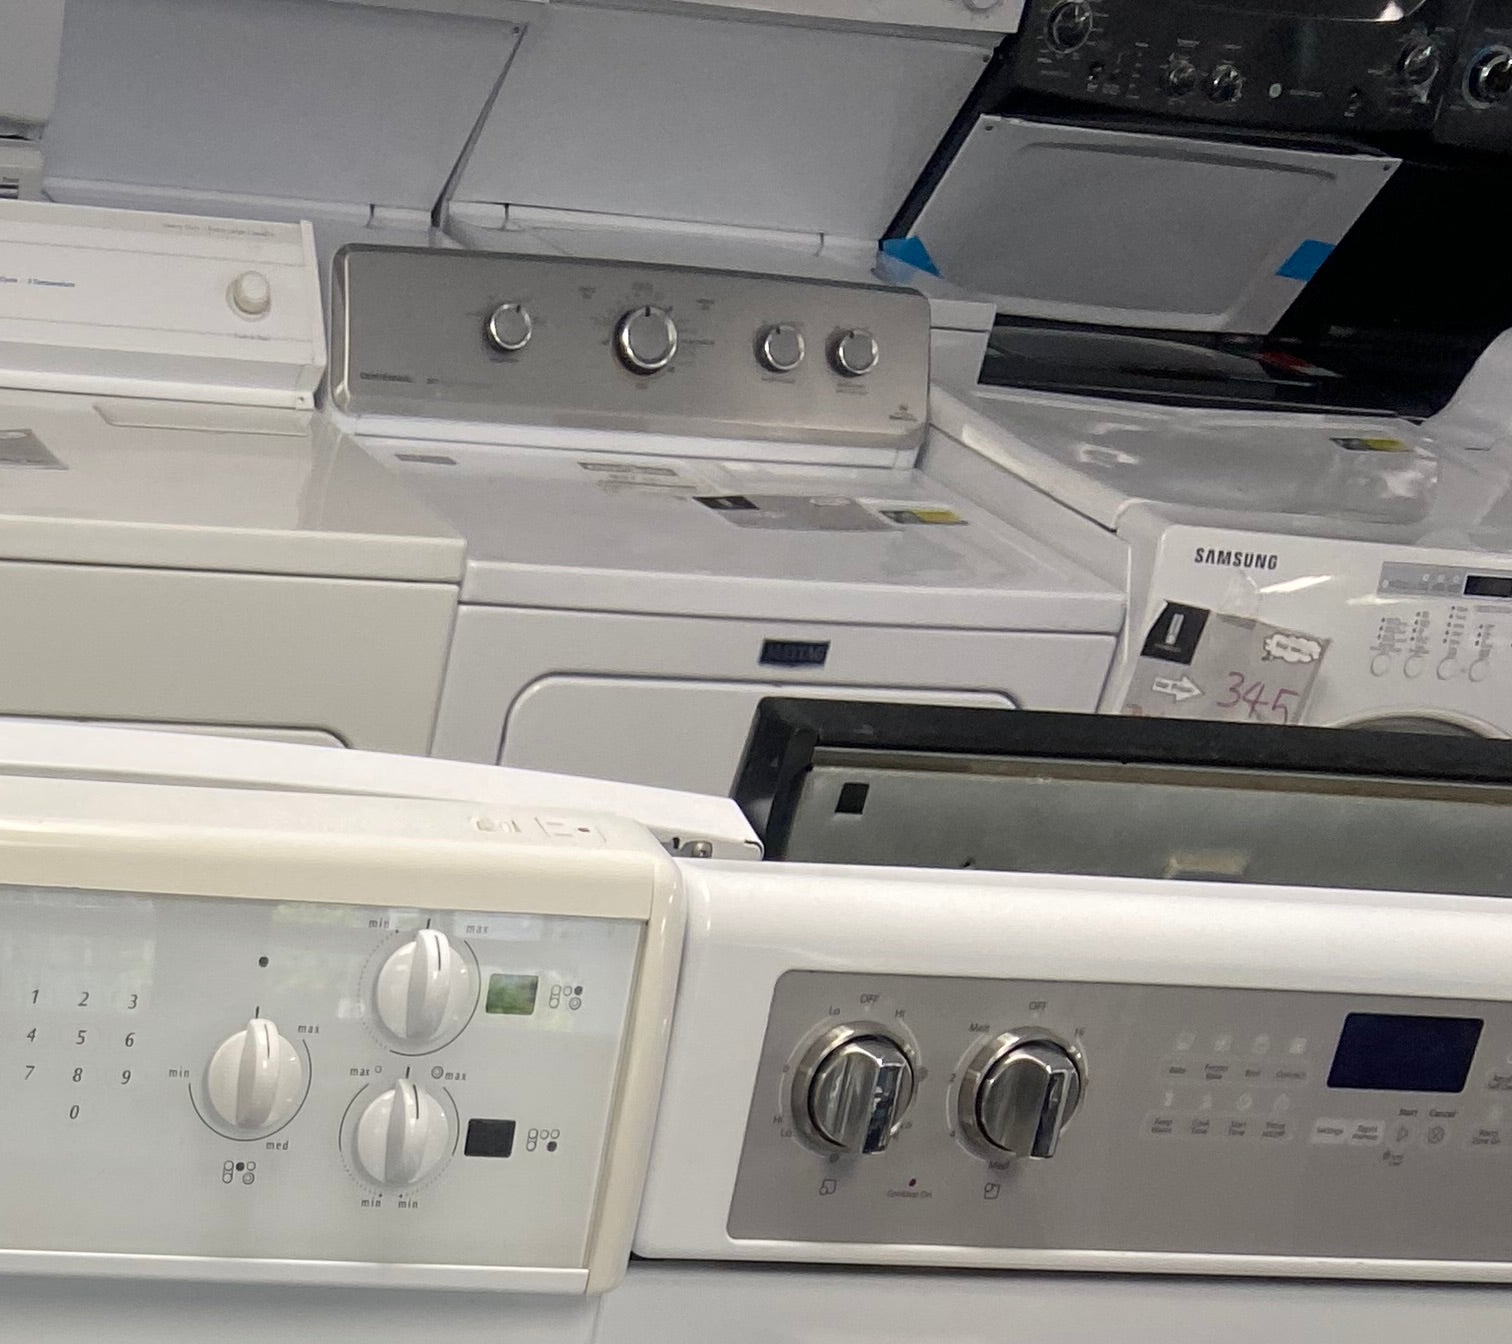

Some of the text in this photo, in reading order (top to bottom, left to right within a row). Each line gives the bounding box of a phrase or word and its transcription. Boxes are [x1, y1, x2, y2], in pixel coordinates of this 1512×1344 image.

[1194, 547, 1278, 571] SAMSUNG
[1216, 671, 1300, 723] 345
[369, 918, 389, 929] min
[466, 924, 488, 935] max
[32, 989, 138, 1009] 1 2 3
[298, 1024, 320, 1034] max
[27, 1028, 135, 1047] 4 5 6
[25, 1065, 131, 1085] 7 8 9
[168, 1067, 190, 1079] min
[350, 1067, 370, 1077] max
[445, 1071, 467, 1082] max
[265, 1140, 288, 1151] med
[361, 1197, 381, 1208] min
[398, 1198, 418, 1210] min
